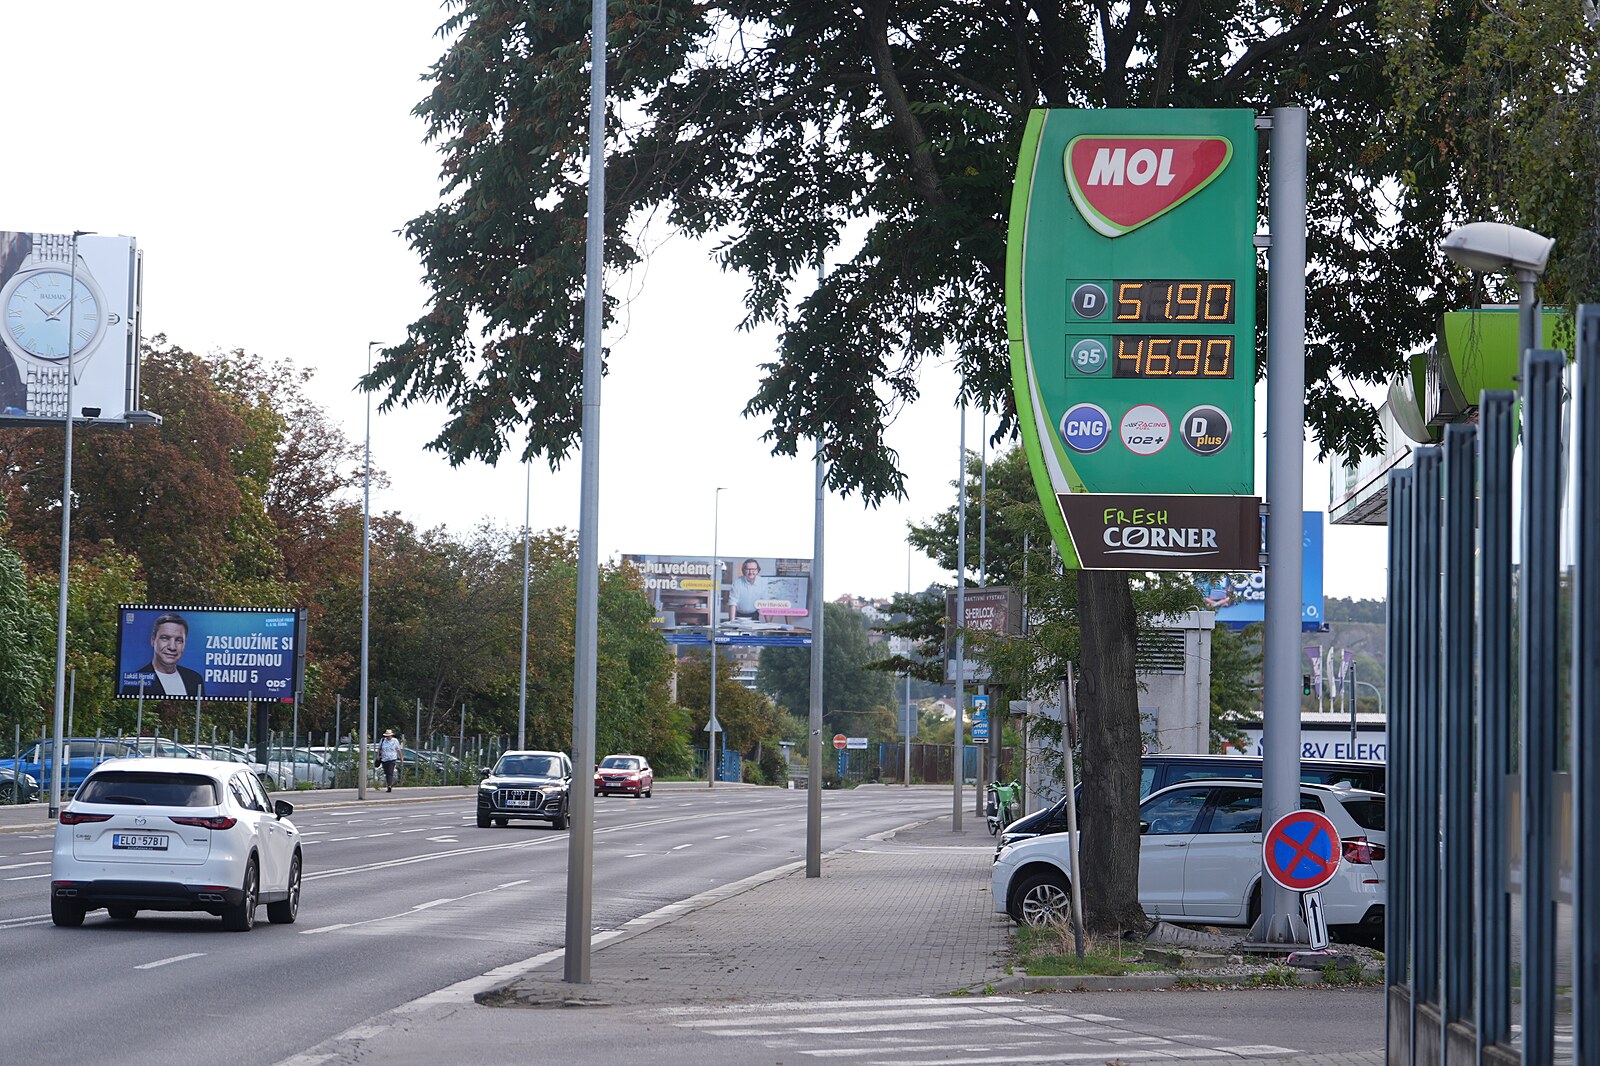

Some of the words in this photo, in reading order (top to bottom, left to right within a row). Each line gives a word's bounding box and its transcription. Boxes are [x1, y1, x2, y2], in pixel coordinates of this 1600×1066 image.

[1086, 148, 1176, 186] MOL
[1083, 293, 1096, 309] D
[1077, 350, 1101, 365] 95
[1067, 421, 1104, 436] CNG
[1190, 417, 1208, 437] D
[1127, 436, 1164, 445] 102+
[1197, 434, 1222, 447] plus
[1103, 508, 1168, 525] FRESH
[1103, 526, 1218, 548] CORNER
[664, 561, 713, 575] vedeme
[965, 606, 994, 619] SHERLOCK
[206, 633, 278, 650] ZASLOUŽÍME
[281, 636, 294, 650] SI
[205, 649, 282, 667] PRŮJEZDNOU
[204, 669, 247, 683] PRAHU
[250, 670, 259, 684] 5
[266, 680, 287, 688] ODS
[975, 699, 987, 716] P
